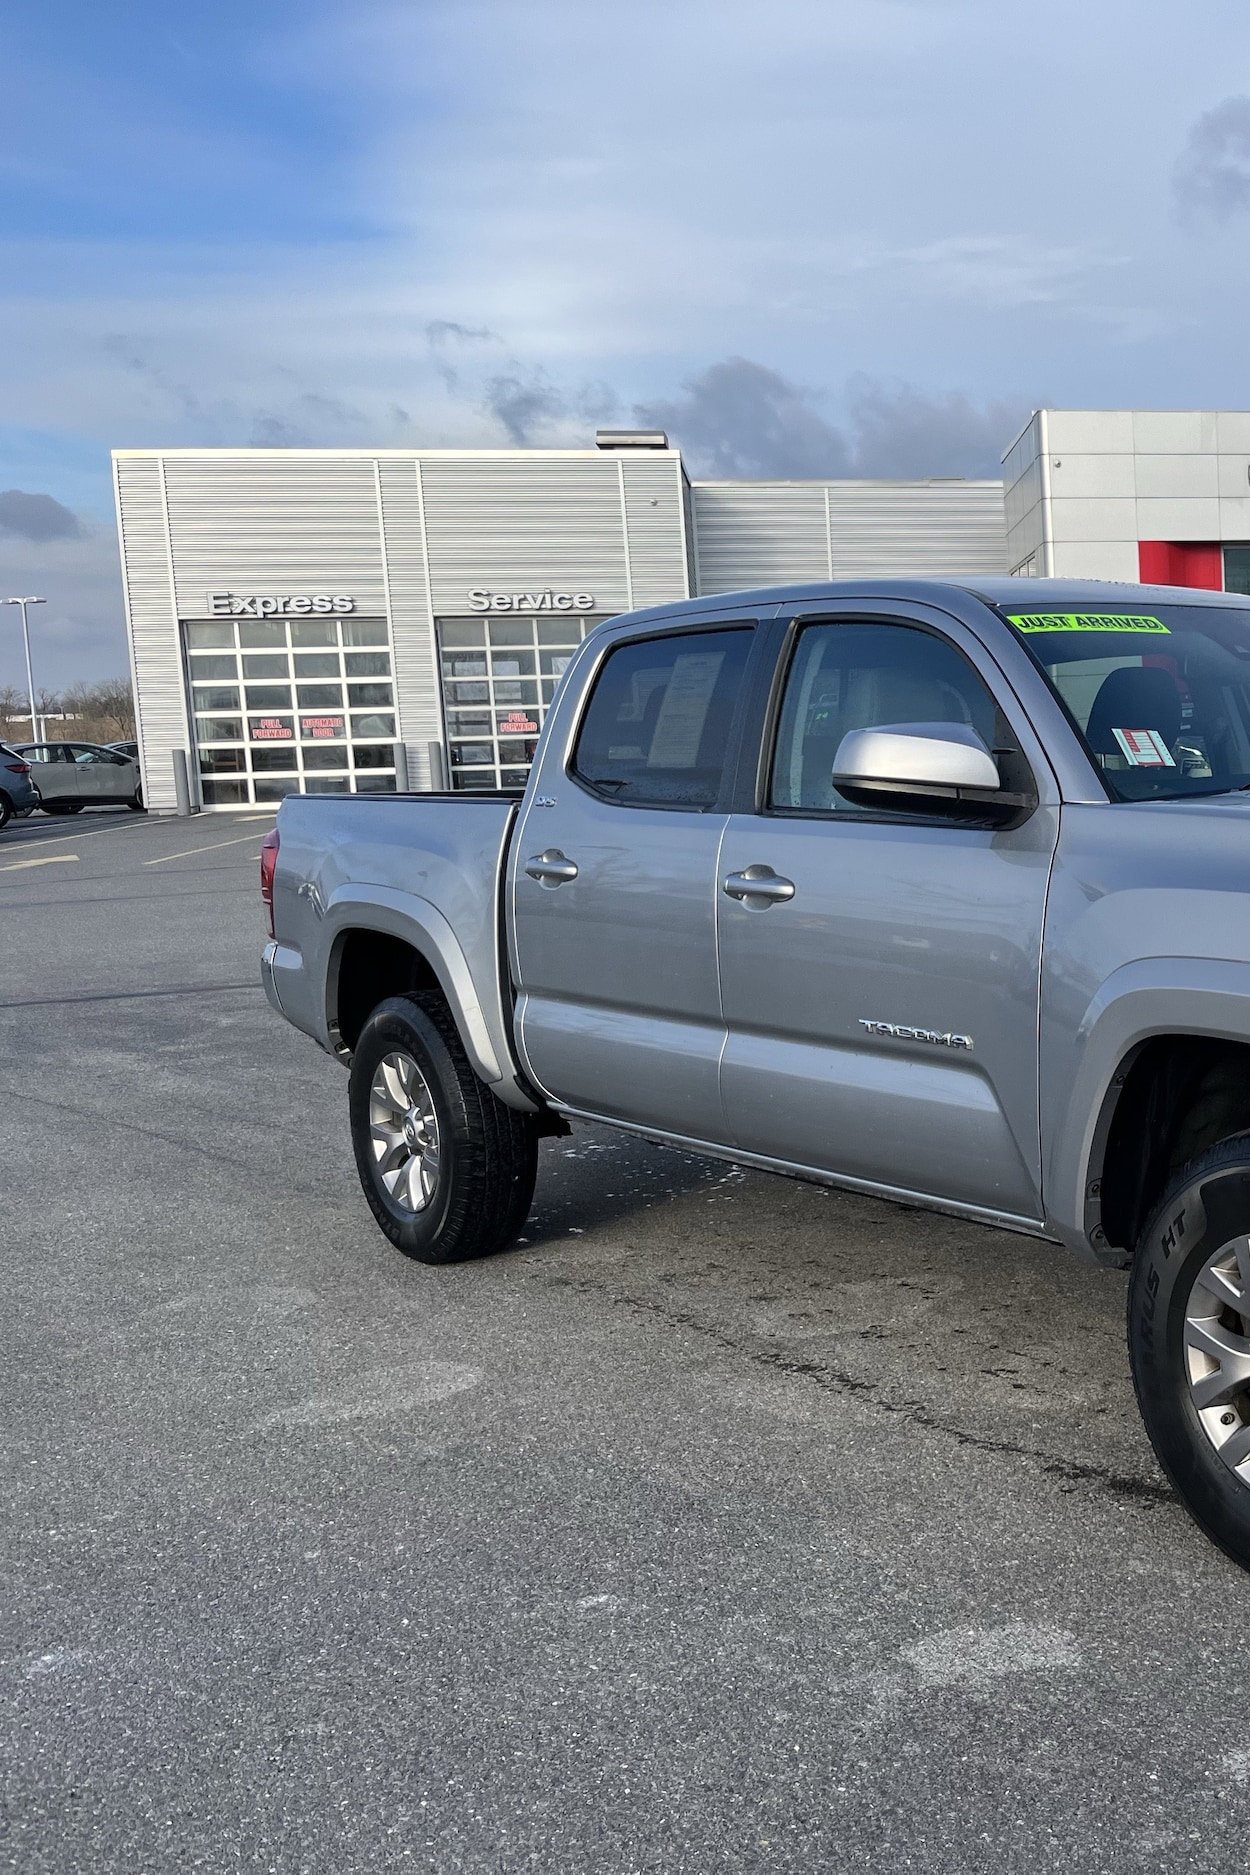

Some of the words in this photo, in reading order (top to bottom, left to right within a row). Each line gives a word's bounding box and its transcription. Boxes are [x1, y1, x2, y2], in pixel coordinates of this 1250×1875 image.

[206, 591, 355, 619] Express
[467, 587, 595, 612] Service
[1018, 616, 1070, 630] JUST
[1075, 615, 1164, 631] ARRIVED
[302, 717, 344, 728] AUTOMATIC
[508, 712, 528, 722] PULL
[260, 718, 282, 728] PULL
[500, 722, 537, 732] FORWARD
[252, 728, 292, 739] FORWARD
[858, 1018, 974, 1050] TACOMA
